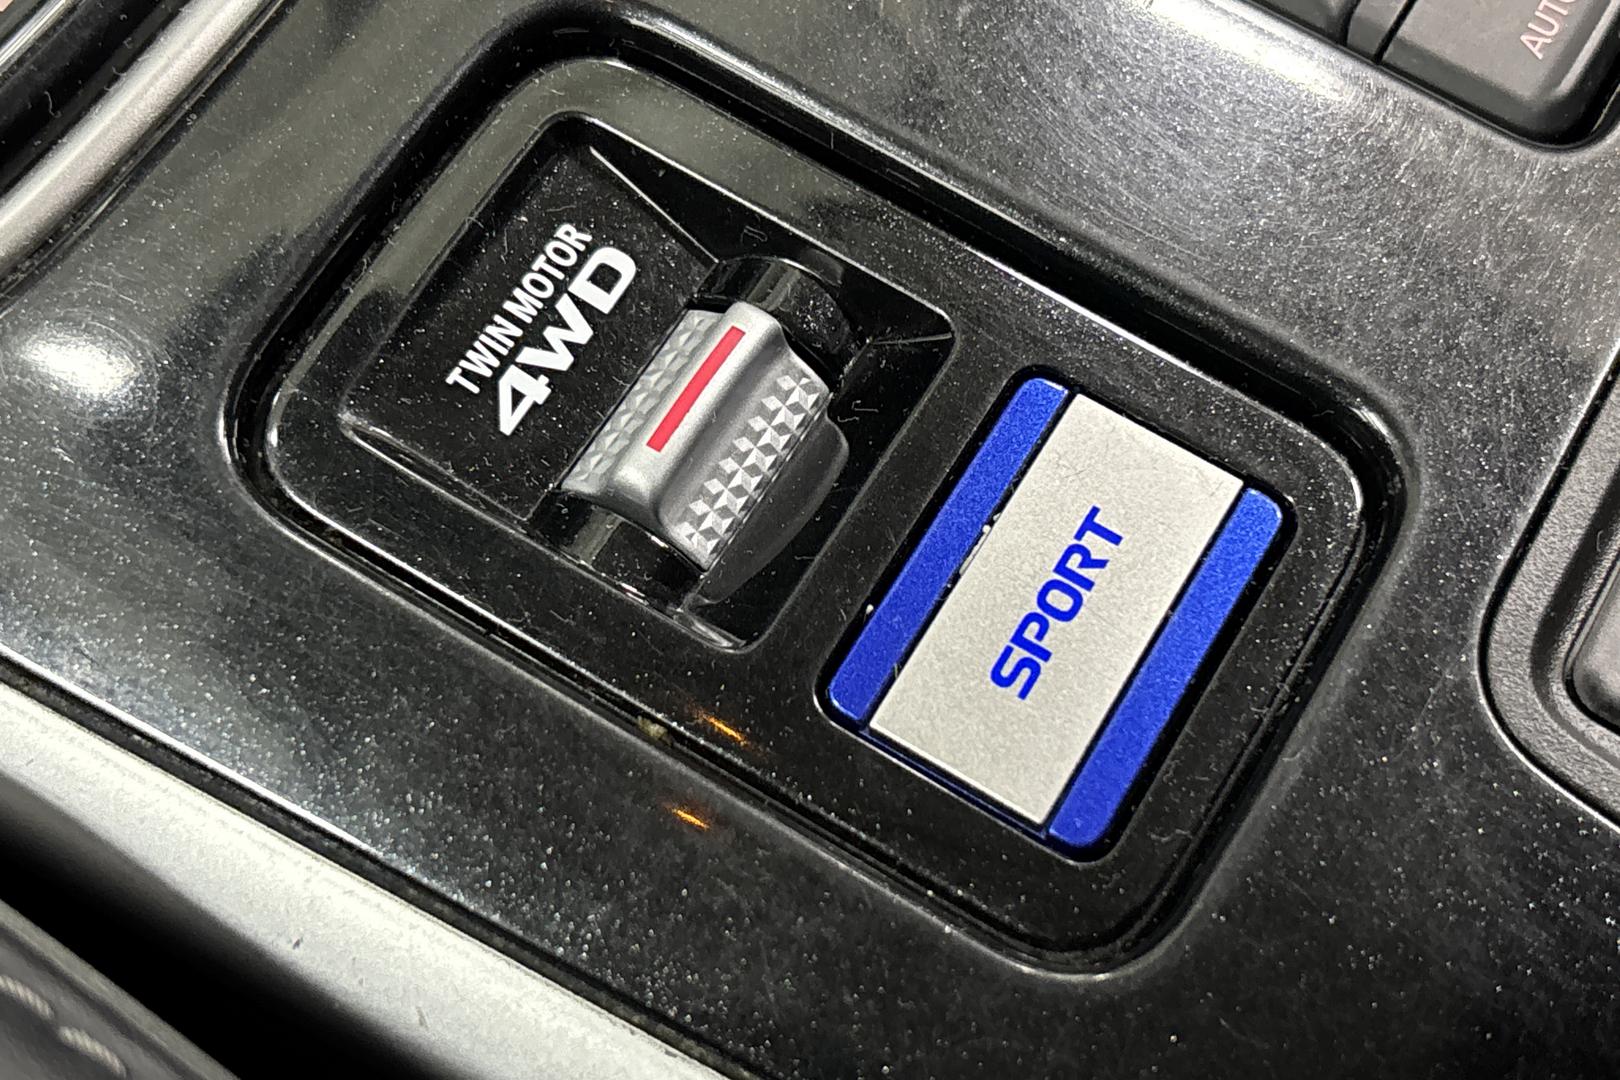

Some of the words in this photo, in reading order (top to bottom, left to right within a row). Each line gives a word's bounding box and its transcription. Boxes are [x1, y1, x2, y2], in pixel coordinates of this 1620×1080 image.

[1520, 0, 1576, 60] AUT
[445, 314, 523, 394] TWIN
[502, 223, 593, 324] MOTOR
[499, 246, 637, 436] 4WD
[990, 505, 1123, 700] SPORT
